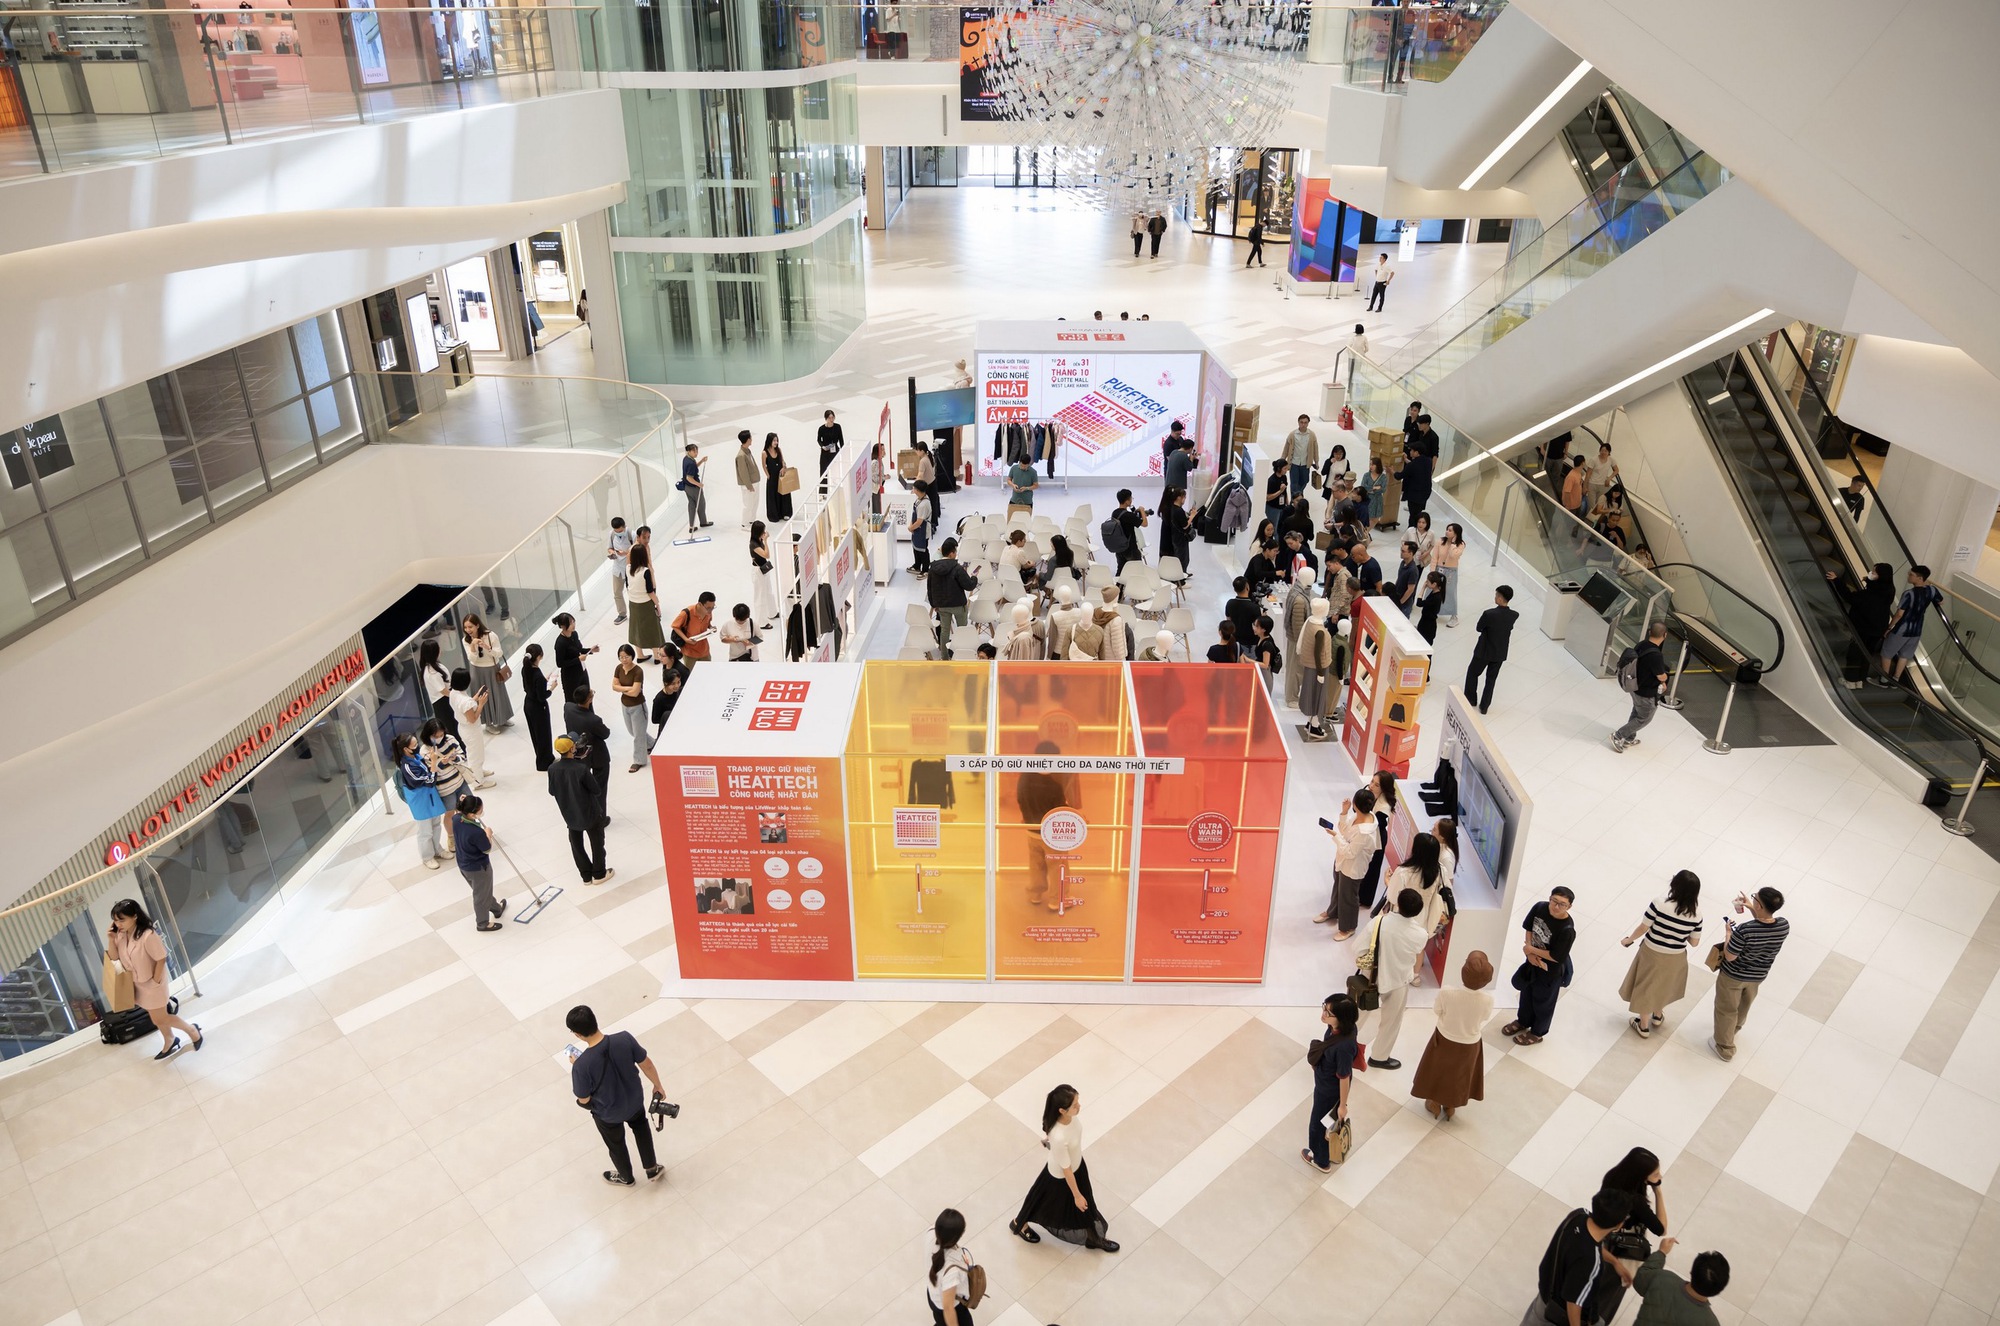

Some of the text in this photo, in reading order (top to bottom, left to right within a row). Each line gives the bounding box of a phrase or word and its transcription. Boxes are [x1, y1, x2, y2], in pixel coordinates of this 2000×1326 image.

[1010, 371, 1029, 380] NGHỆ
[1051, 368, 1077, 376] THÁNG
[991, 381, 1025, 398] NHẬT
[1099, 384, 1134, 406] INSULATED
[1104, 377, 1169, 415] PUFFTECH
[1081, 394, 1142, 431] HEATTECH
[36, 431, 56, 448] peau
[1068, 429, 1102, 452] TECHNOLOGY
[33, 445, 51, 457] AUTÉ
[721, 687, 746, 721] LifeWear
[1446, 707, 1471, 755] HEATTECH
[128, 648, 365, 848] LOTTE WORLD AQUARIUM
[756, 766, 775, 774] PHỤC
[794, 766, 816, 775] NHIỆT
[969, 758, 988, 768] CẤP
[991, 759, 1003, 769] ĐỘ
[1007, 760, 1023, 768] GIỮ
[1026, 760, 1054, 770] NHIỆT
[1057, 760, 1075, 768] CHO
[1079, 760, 1093, 768] ĐA
[1096, 760, 1121, 770] DẠNG
[1125, 760, 1146, 770] THỜI
[1150, 760, 1170, 770] TIẾT
[728, 775, 818, 789] HEATTECH
[730, 789, 818, 800] CÔNG NGHỆ NHẬT BẢN
